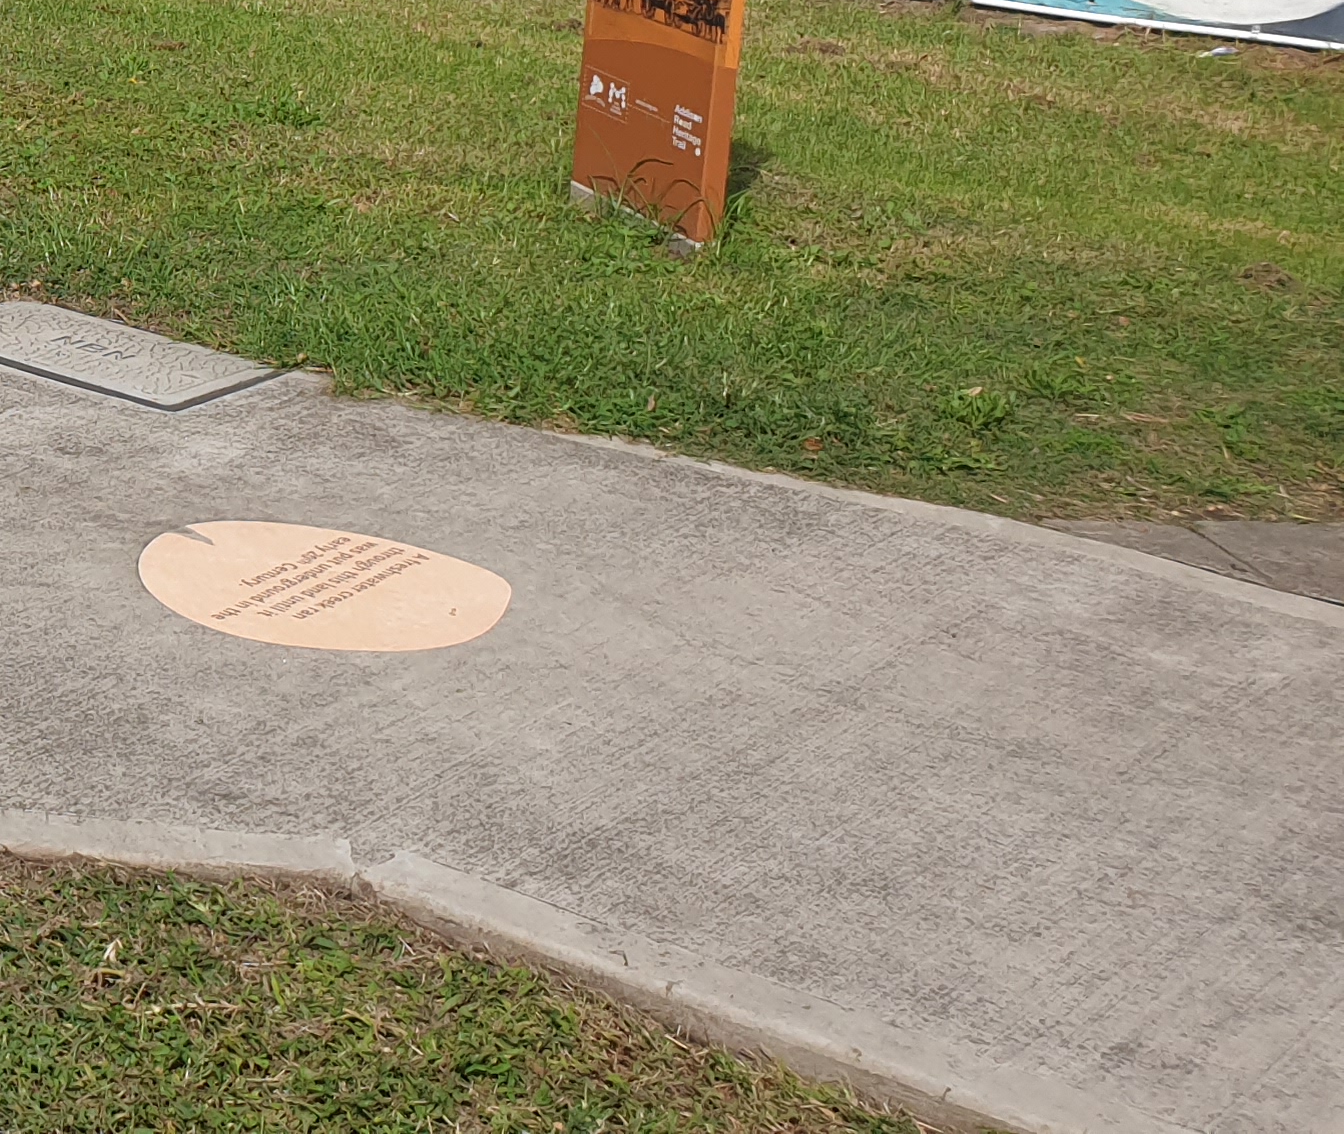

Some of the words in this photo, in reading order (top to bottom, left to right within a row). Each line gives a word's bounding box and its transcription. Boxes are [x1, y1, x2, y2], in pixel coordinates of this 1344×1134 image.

[314, 536, 351, 555] early
[349, 541, 378, 555] was
[326, 551, 348, 566] put
[352, 547, 406, 572] through
[414, 553, 430, 561] A
[238, 562, 297, 588] Century.
[248, 561, 331, 603] underground
[329, 567, 358, 585] this
[350, 556, 421, 593] freshwater
[300, 582, 334, 598] land
[238, 599, 254, 608] in
[272, 594, 304, 615] until
[318, 590, 353, 608] creek
[210, 607, 239, 621] the
[256, 605, 275, 618] it
[291, 604, 317, 620] ran
